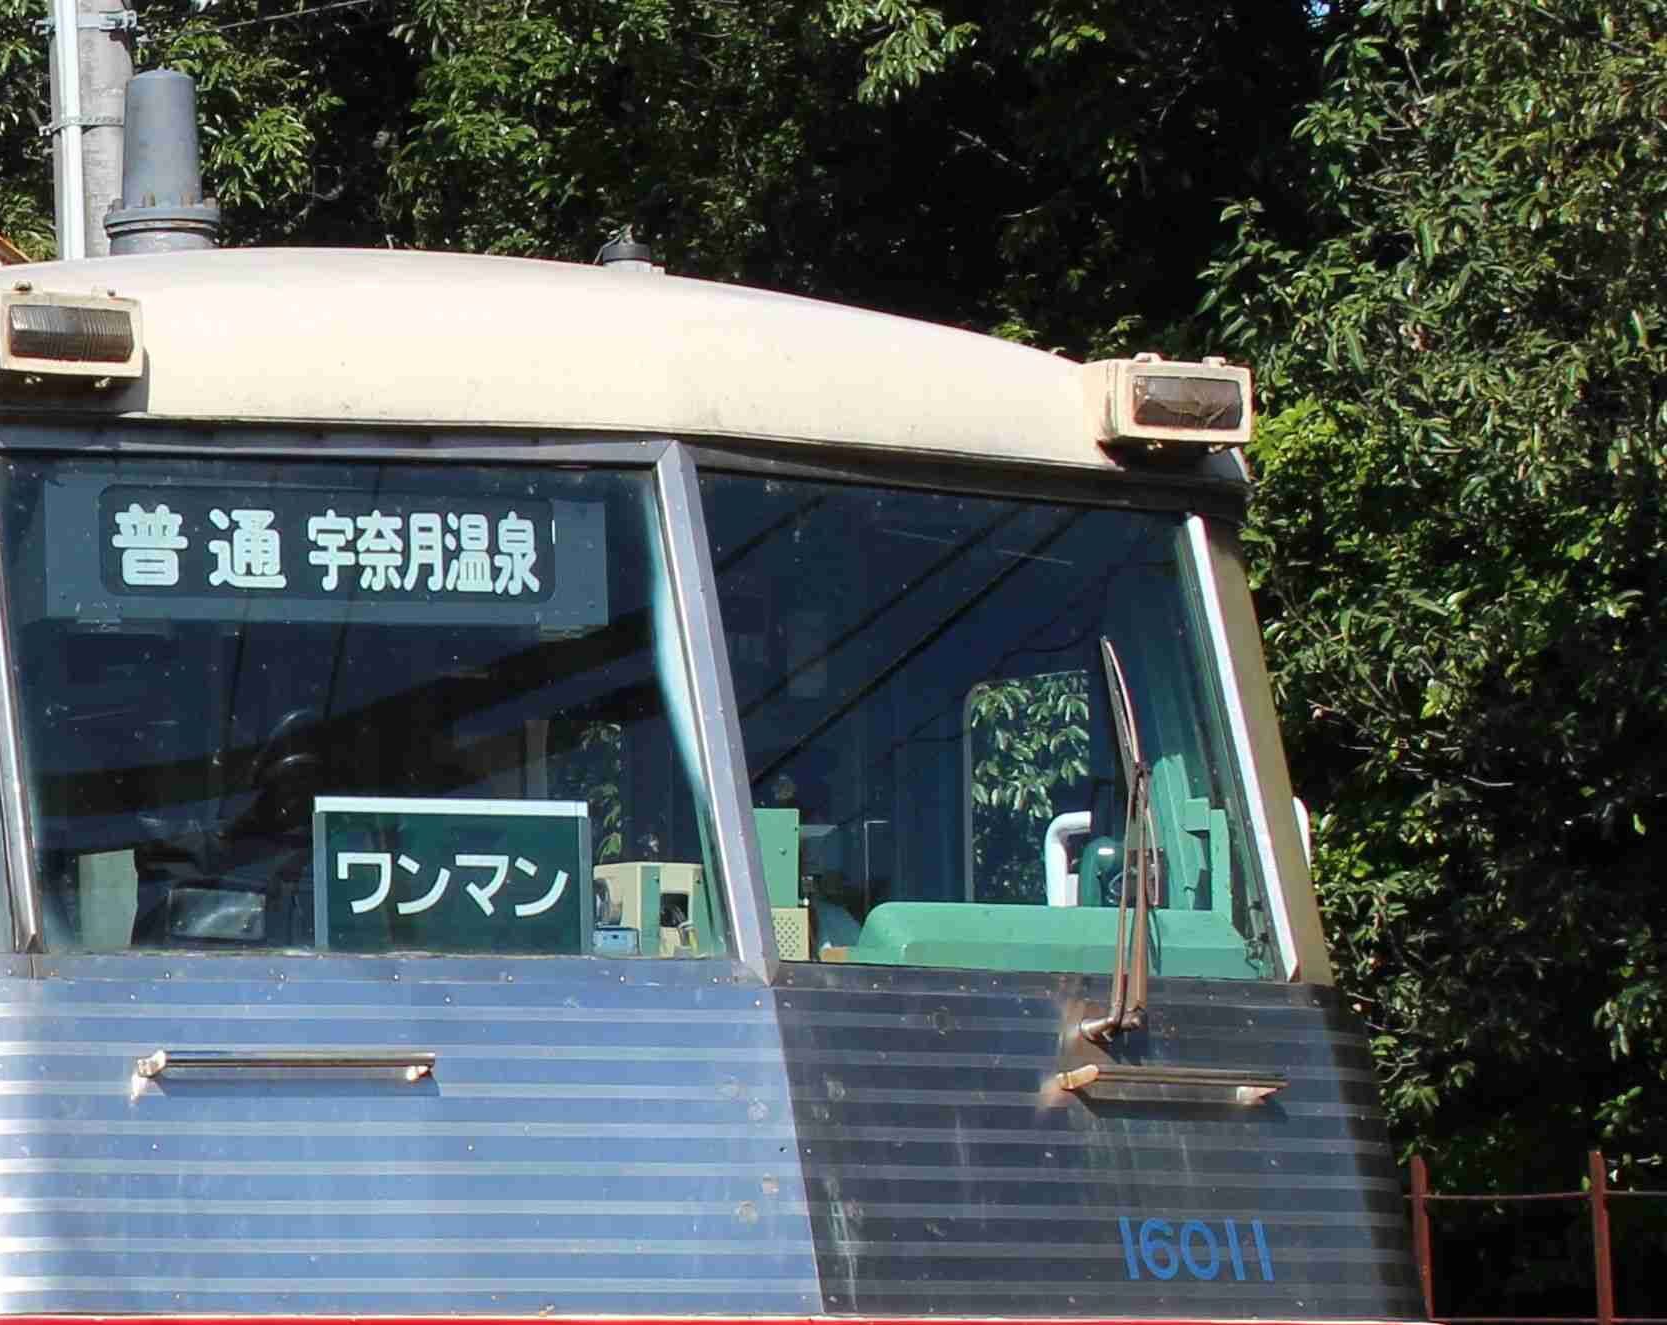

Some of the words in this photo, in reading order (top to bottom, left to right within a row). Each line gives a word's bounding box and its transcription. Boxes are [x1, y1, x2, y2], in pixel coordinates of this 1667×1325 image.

[112, 503, 286, 588] 普通
[308, 509, 539, 595] 宇奈月温泉
[337, 852, 569, 917] ワンマン
[1118, 1215, 1275, 1281] 16011
